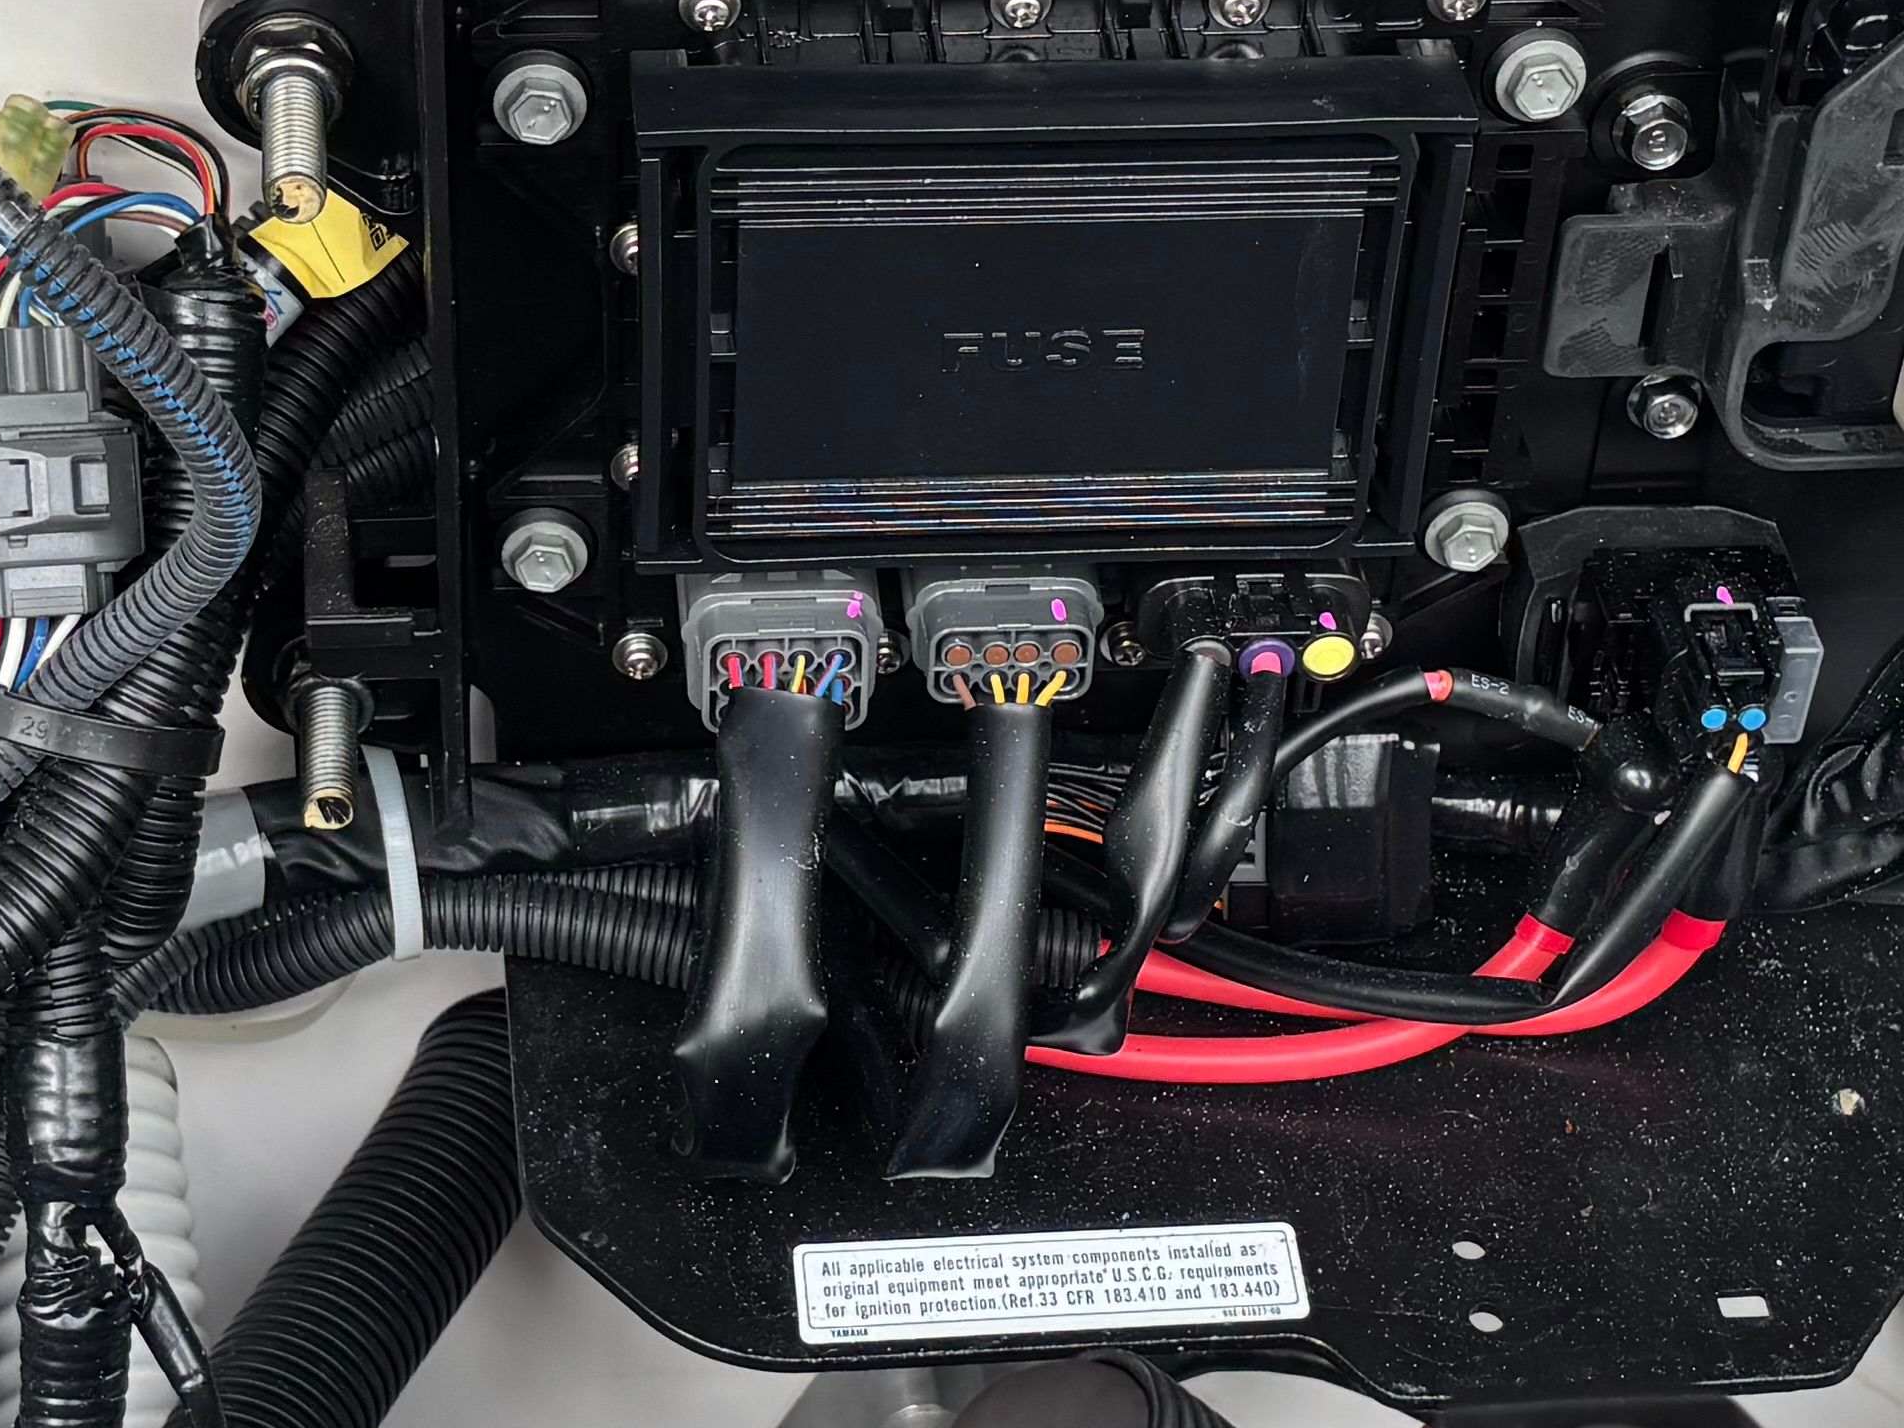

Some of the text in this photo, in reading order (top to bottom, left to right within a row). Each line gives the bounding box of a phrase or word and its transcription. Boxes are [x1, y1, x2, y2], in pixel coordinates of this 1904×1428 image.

[941, 328, 1146, 373] FUSE
[1471, 673, 1511, 696] ES-2
[821, 1240, 1257, 1279] All applicable electrical system components installed as
[823, 1280, 880, 1300] original
[887, 1276, 965, 1297] equipment
[973, 1274, 1010, 1290] meet
[1180, 1261, 1279, 1281] requirements
[824, 1303, 846, 1319] for
[854, 1299, 912, 1319] ignition
[1066, 1290, 1095, 1306] CFR
[1104, 1286, 1167, 1304] 183.410
[1175, 1284, 1202, 1300] and
[1210, 1280, 1281, 1298] 183.440)
[830, 1327, 869, 1338] YAMAHA
